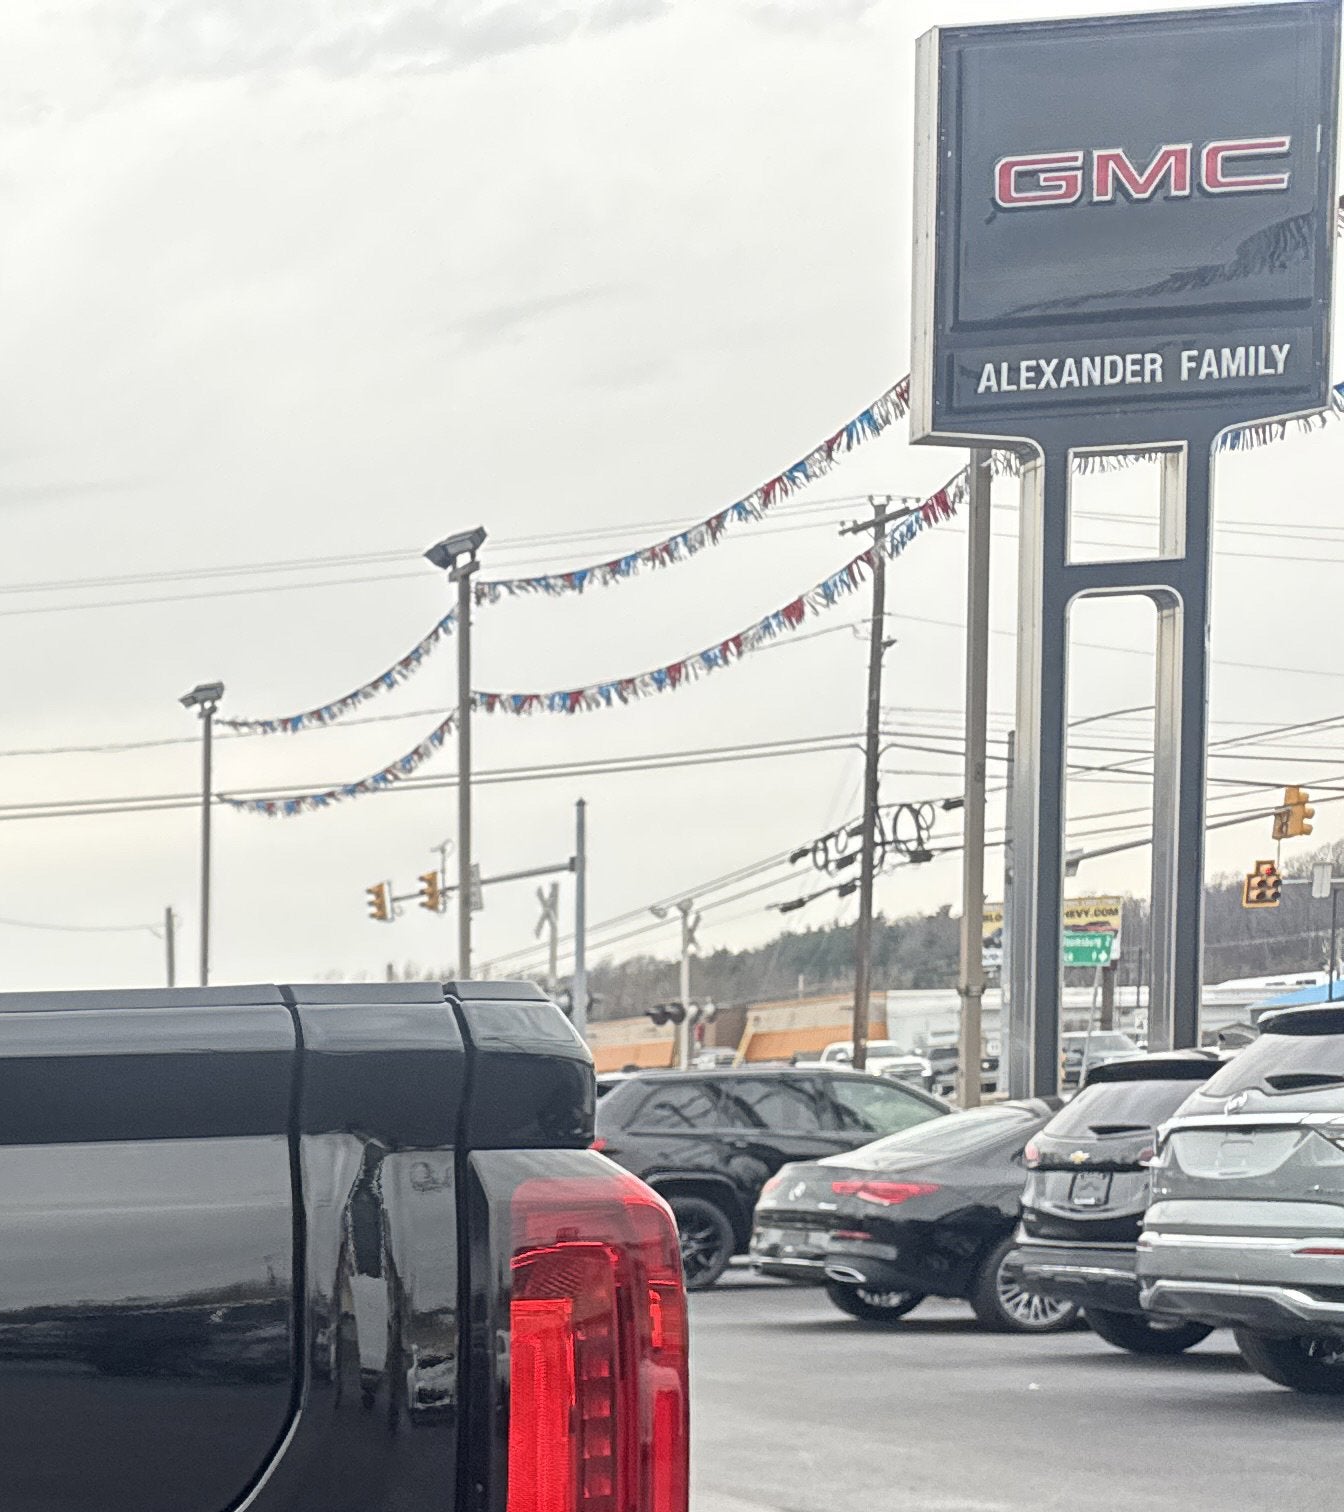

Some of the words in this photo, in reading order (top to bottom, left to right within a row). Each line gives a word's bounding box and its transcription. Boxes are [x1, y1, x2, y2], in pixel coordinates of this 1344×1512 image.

[994, 136, 1292, 209] GMC
[977, 352, 1163, 394] ALEXANDER
[1180, 343, 1290, 381] FAMILY
